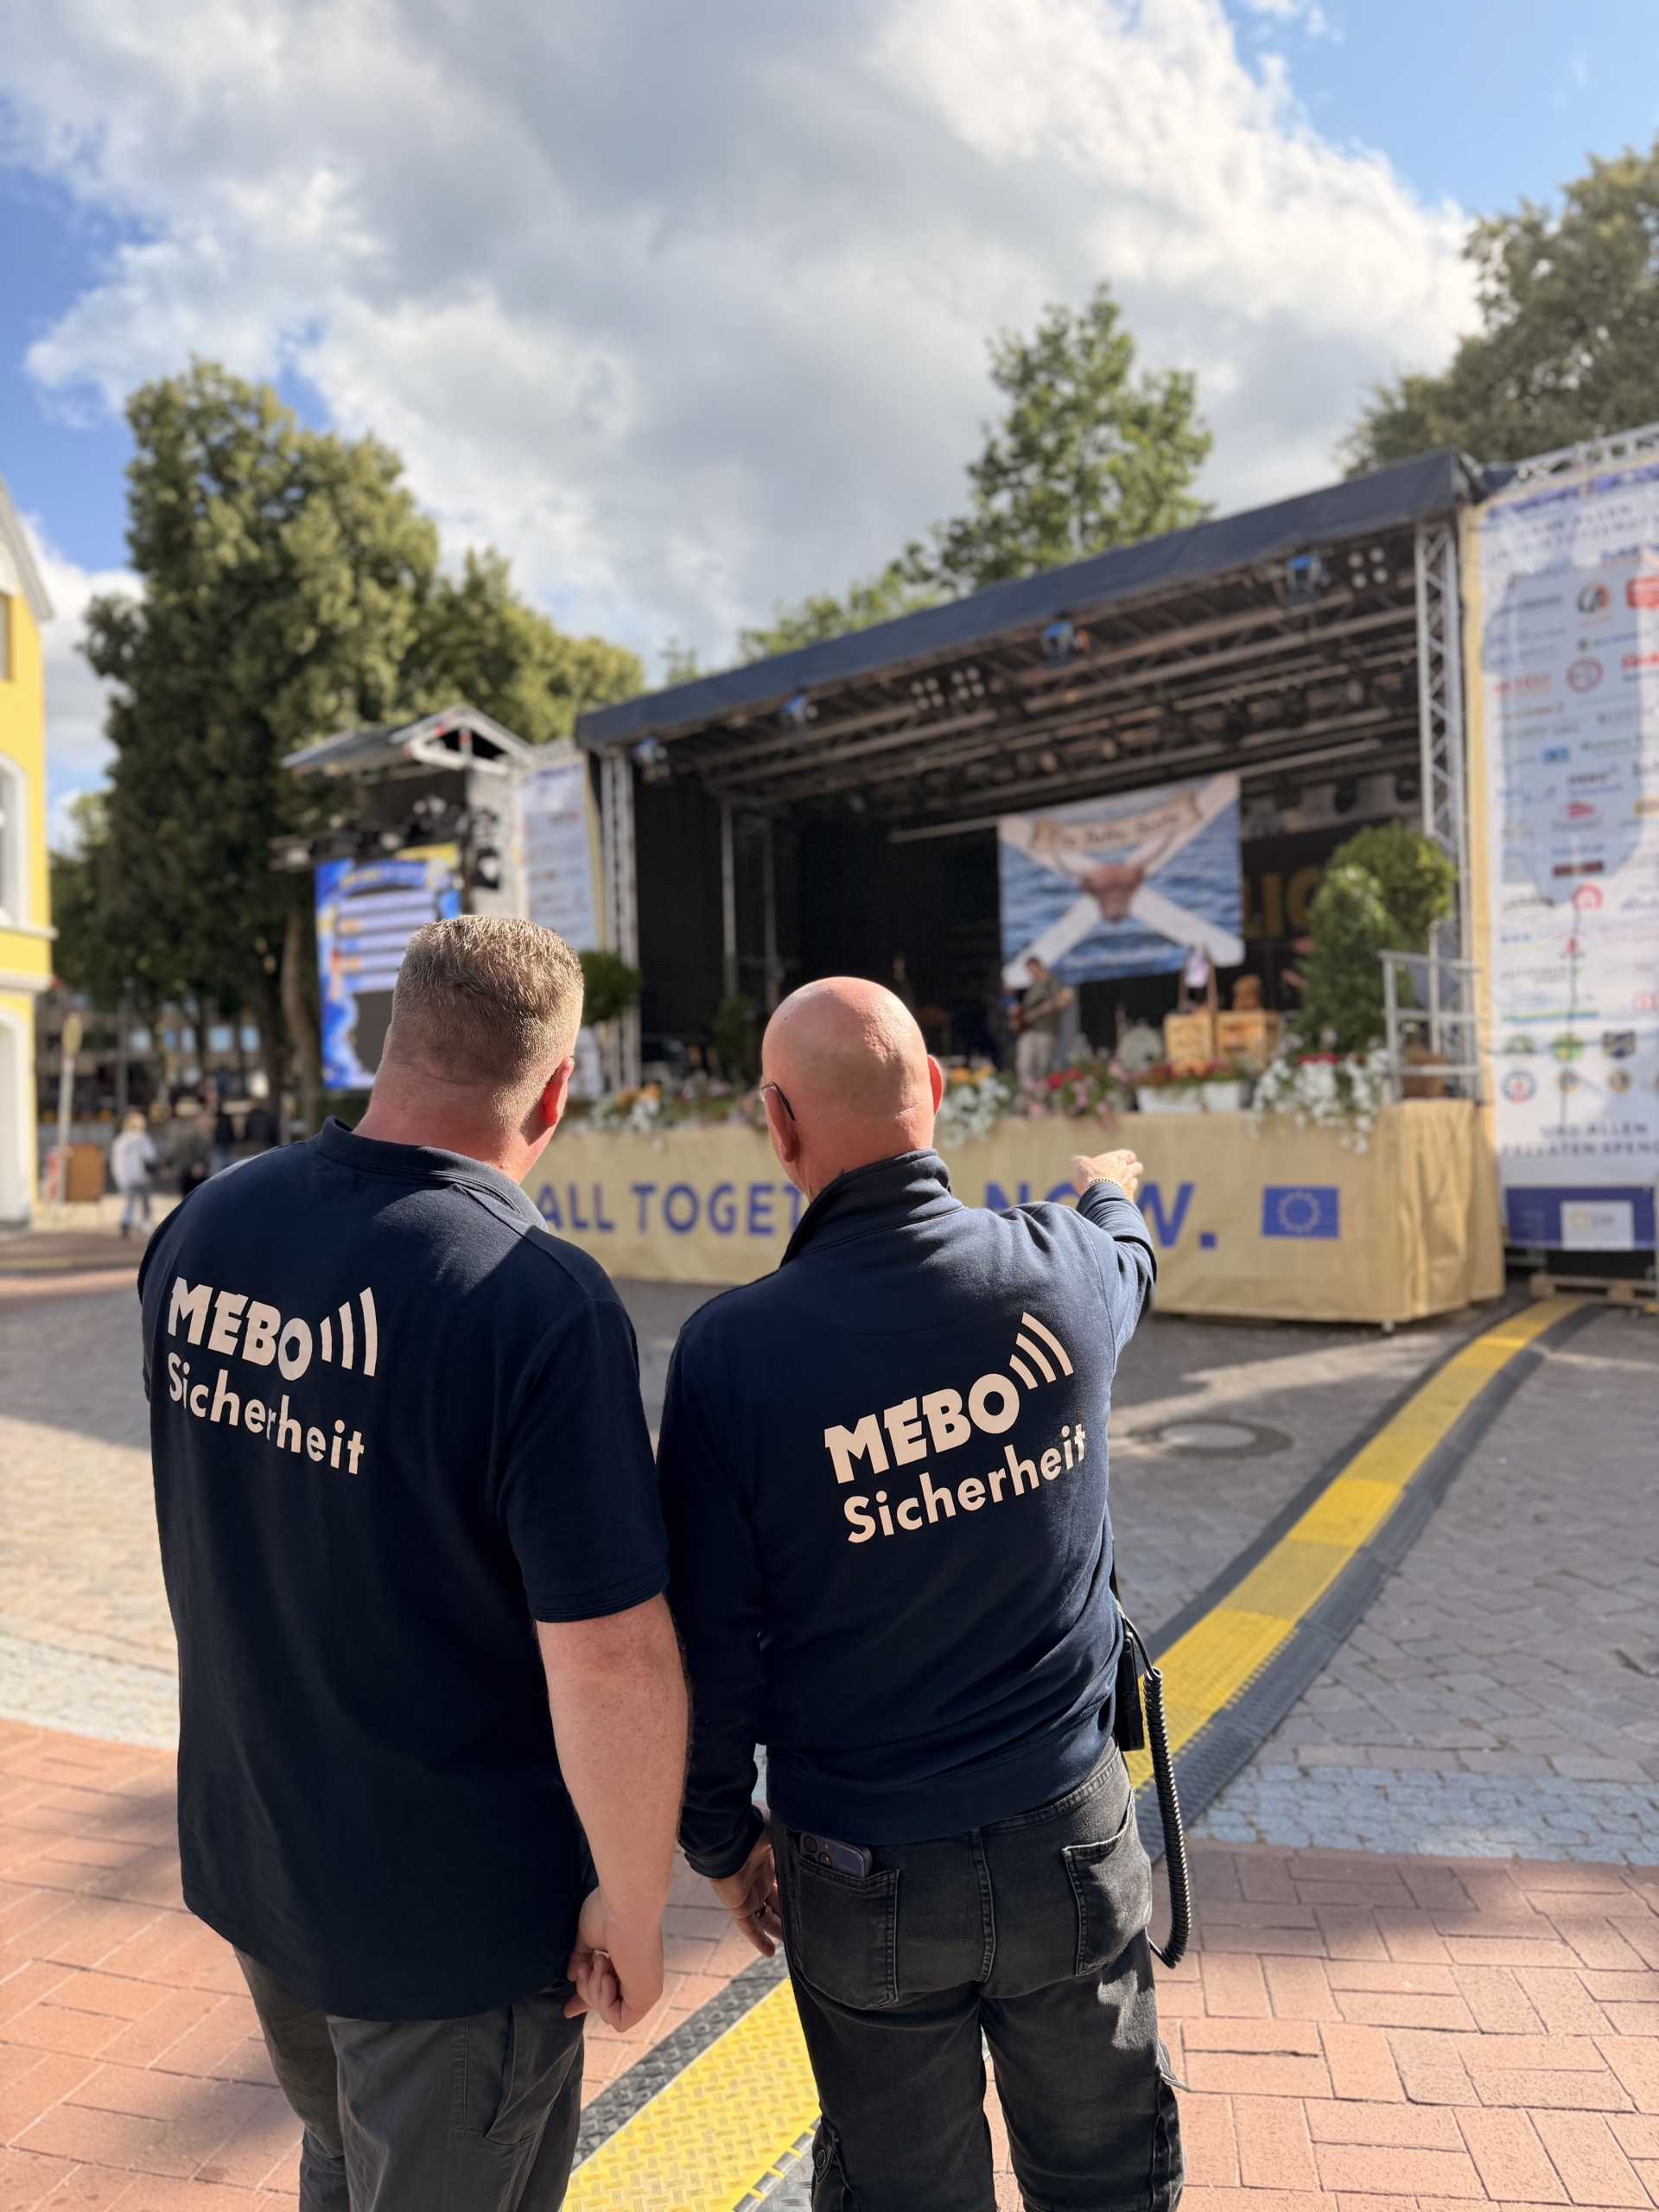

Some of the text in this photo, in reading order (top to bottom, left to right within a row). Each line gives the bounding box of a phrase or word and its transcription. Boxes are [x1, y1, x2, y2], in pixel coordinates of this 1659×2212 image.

[536, 1181, 614, 1232] ALL
[168, 1276, 314, 1381] MEBO
[168, 1351, 365, 1475] Sicherheit
[824, 1373, 1020, 1484] MEBO
[843, 1423, 1086, 1543] Sicherheit
